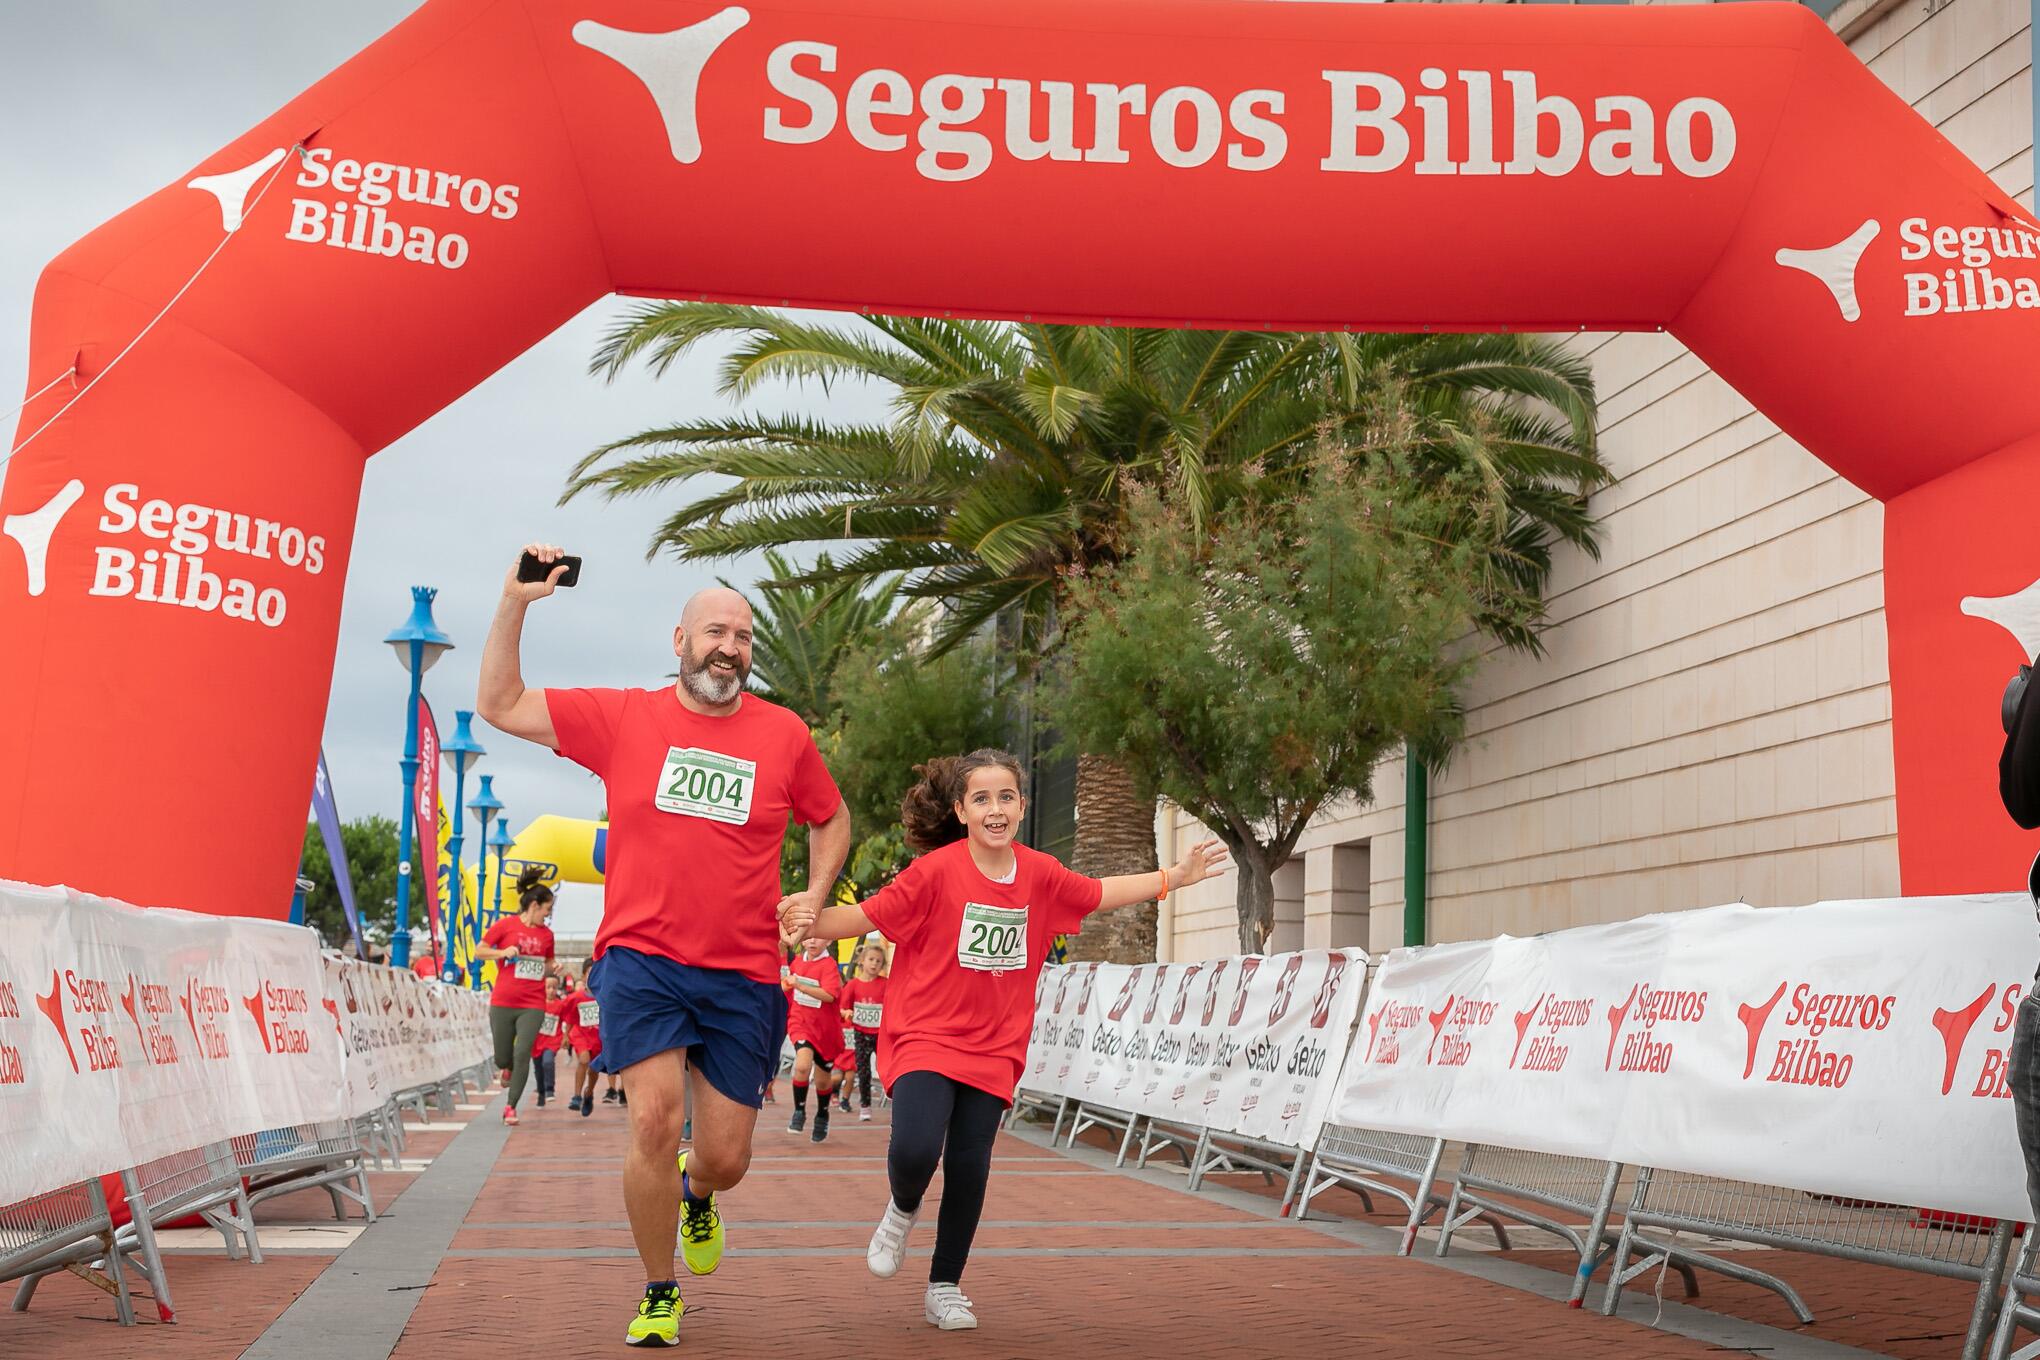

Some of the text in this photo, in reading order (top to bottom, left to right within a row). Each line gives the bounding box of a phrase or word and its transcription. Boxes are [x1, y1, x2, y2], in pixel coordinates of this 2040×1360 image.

[762, 40, 1738, 182] Seguros Bilbao
[296, 147, 520, 220] Seguros
[285, 198, 469, 269] Bilbao
[1899, 217, 2040, 267] Segur
[99, 483, 326, 575] Seguros
[88, 546, 287, 627] Bilbao
[668, 766, 743, 807] 2004
[519, 960, 543, 975] 2049
[856, 1009, 880, 1022] 2050
[1538, 993, 1594, 1034] Seguros
[1633, 983, 1708, 1027] Seguros
[1785, 983, 1896, 1036] Seguros
[1151, 1029, 1181, 1064] Getxo
[1245, 1034, 1281, 1073] Getxo
[1288, 1035, 1326, 1078] Getxo
[1521, 1036, 1569, 1073] Bilbao
[1618, 1032, 1674, 1075] Bilbao
[1766, 1039, 1854, 1088] Bilbao
